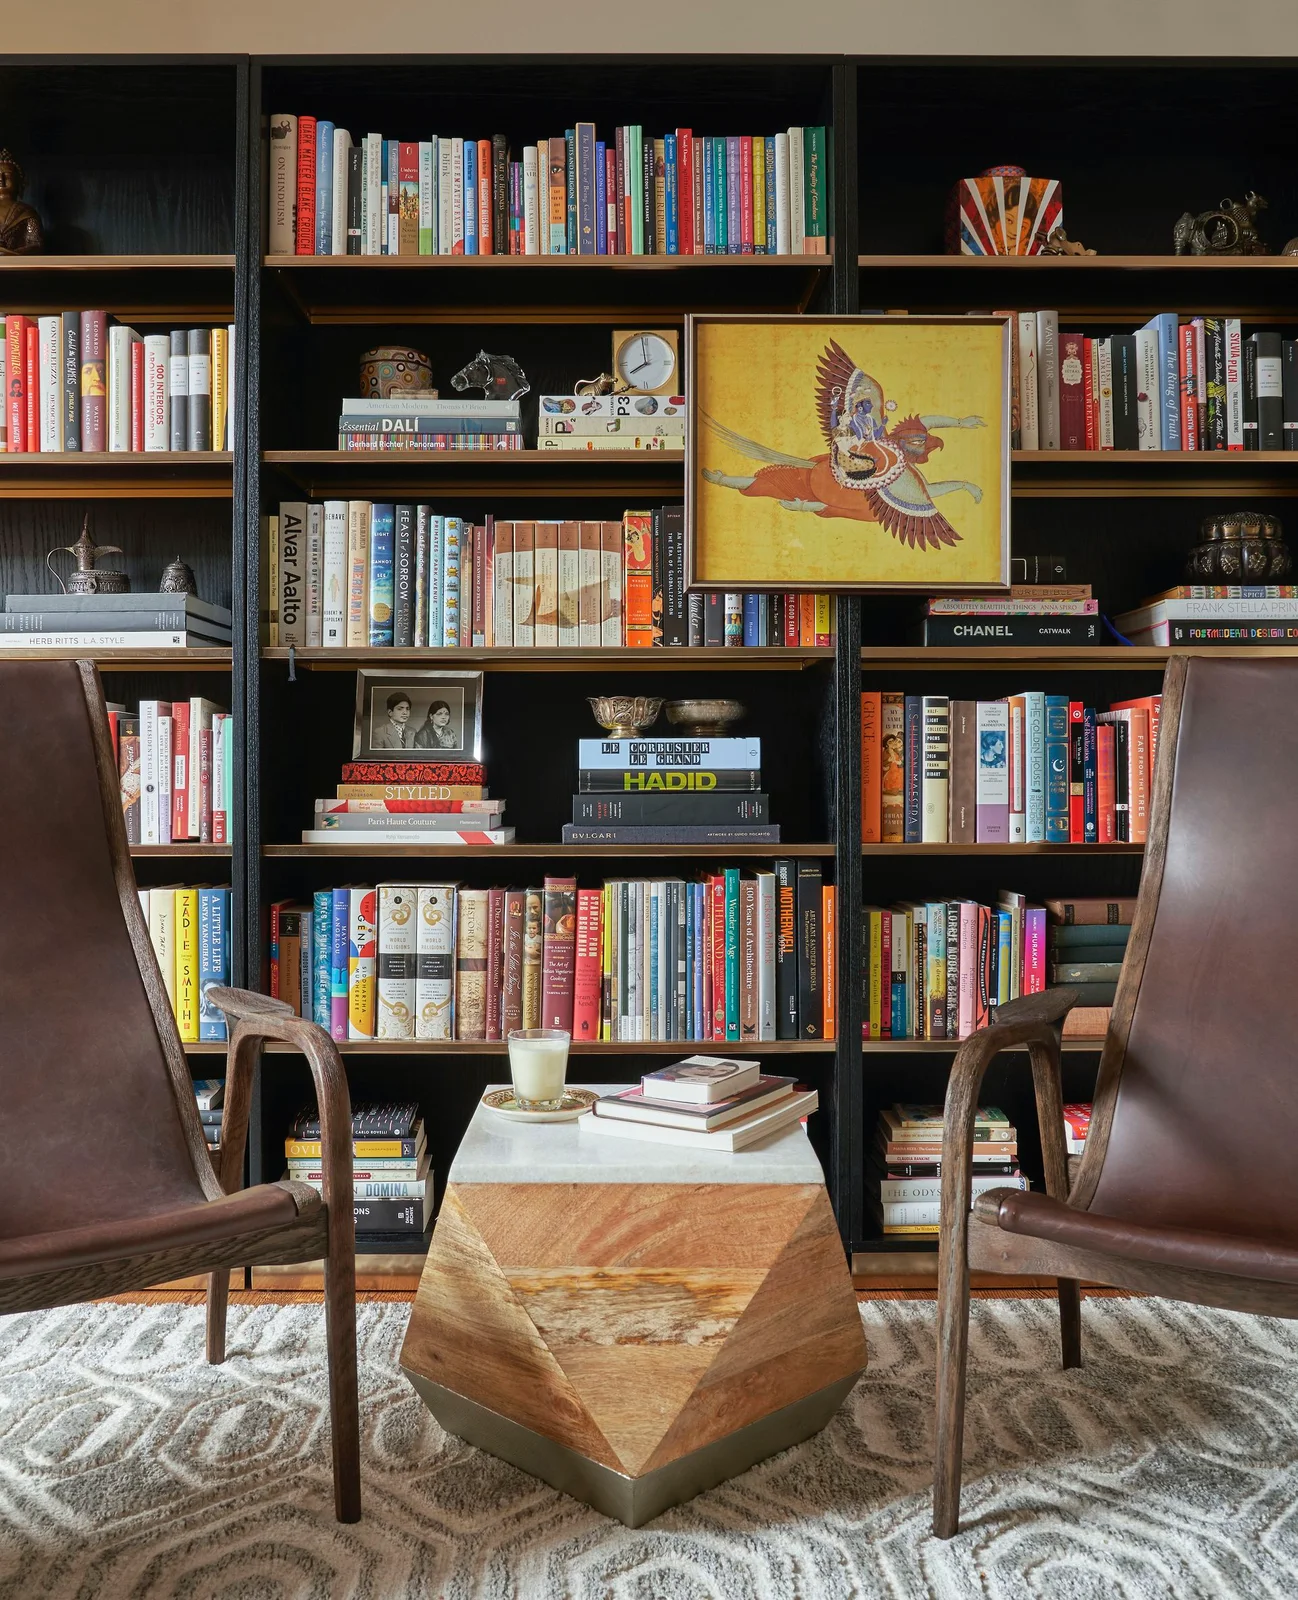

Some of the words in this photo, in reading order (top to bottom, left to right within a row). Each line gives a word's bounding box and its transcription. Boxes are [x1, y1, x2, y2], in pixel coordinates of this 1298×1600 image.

[301, 123, 312, 144] DARK
[277, 157, 285, 171] ON
[301, 148, 312, 179] MATTER
[442, 153, 450, 177] blink
[656, 180, 664, 195] THE
[810, 164, 818, 188] Fragility
[277, 173, 285, 226] HINDUISM
[301, 187, 311, 212] BLAKE
[466, 187, 474, 219] PHILOSOPHY
[481, 178, 489, 208] PHILOSOPHY
[300, 216, 311, 249] CROUCH
[466, 221, 474, 236] BITES
[657, 198, 665, 247] REPUBLIC
[85, 323, 90, 332] DA
[10, 329, 21, 375] SYMPATHIZER
[1045, 325, 1053, 356] VANITY
[1230, 333, 1240, 358] SYLVIA
[156, 364, 164, 379] 100
[1046, 360, 1054, 379] FAIR
[1167, 350, 1177, 370] The
[1228, 360, 1238, 383] PLATH
[1166, 372, 1177, 396] Ring
[156, 381, 164, 425] INTERIORS
[1166, 399, 1178, 410] of
[342, 422, 379, 431] Essential
[382, 417, 419, 432] DALÍ
[1169, 412, 1178, 440] Truth
[400, 510, 409, 544] FEAST
[284, 514, 302, 567] Alvar
[400, 553, 409, 600] SORROW
[283, 571, 302, 625] Aalto
[350, 558, 364, 622] AMERICANAH
[690, 593, 702, 629] Wonder
[1186, 603, 1225, 613] FRANK
[1227, 602, 1268, 613] STELLA
[953, 625, 1013, 636] CHANEL
[1250, 629, 1284, 638] DESIGN
[1030, 696, 1041, 717] THE
[863, 701, 875, 743] GRACE
[602, 742, 620, 754] LE
[629, 742, 710, 754] CORBUSIER
[1032, 719, 1041, 754] GOLDEN
[629, 754, 647, 765] LE
[656, 754, 701, 765] GRAND
[1031, 756, 1041, 786] HOUSE
[385, 786, 451, 800] STYLED
[623, 772, 717, 791] HADID
[368, 817, 385, 825] Paris
[386, 818, 407, 826] Haute
[408, 818, 437, 826] Couture
[779, 866, 787, 886] ROBERT
[212, 895, 219, 903] A
[579, 896, 588, 913] THE
[762, 894, 773, 928] Jackson
[590, 896, 599, 931] STAMPED
[746, 904, 754, 927] Years
[780, 887, 794, 953] MOTHERWELL
[212, 907, 221, 945] LITTLE
[357, 914, 365, 949] GENE
[578, 916, 588, 957] BEGINNING
[714, 902, 724, 959] THAILAND
[746, 927, 754, 936] of
[589, 937, 598, 957] FROM
[728, 943, 736, 959] Age
[764, 931, 773, 964] Pollock
[212, 948, 221, 972] LIFE
[746, 938, 754, 989] Architecture
[366, 1183, 409, 1197] DOMINA
